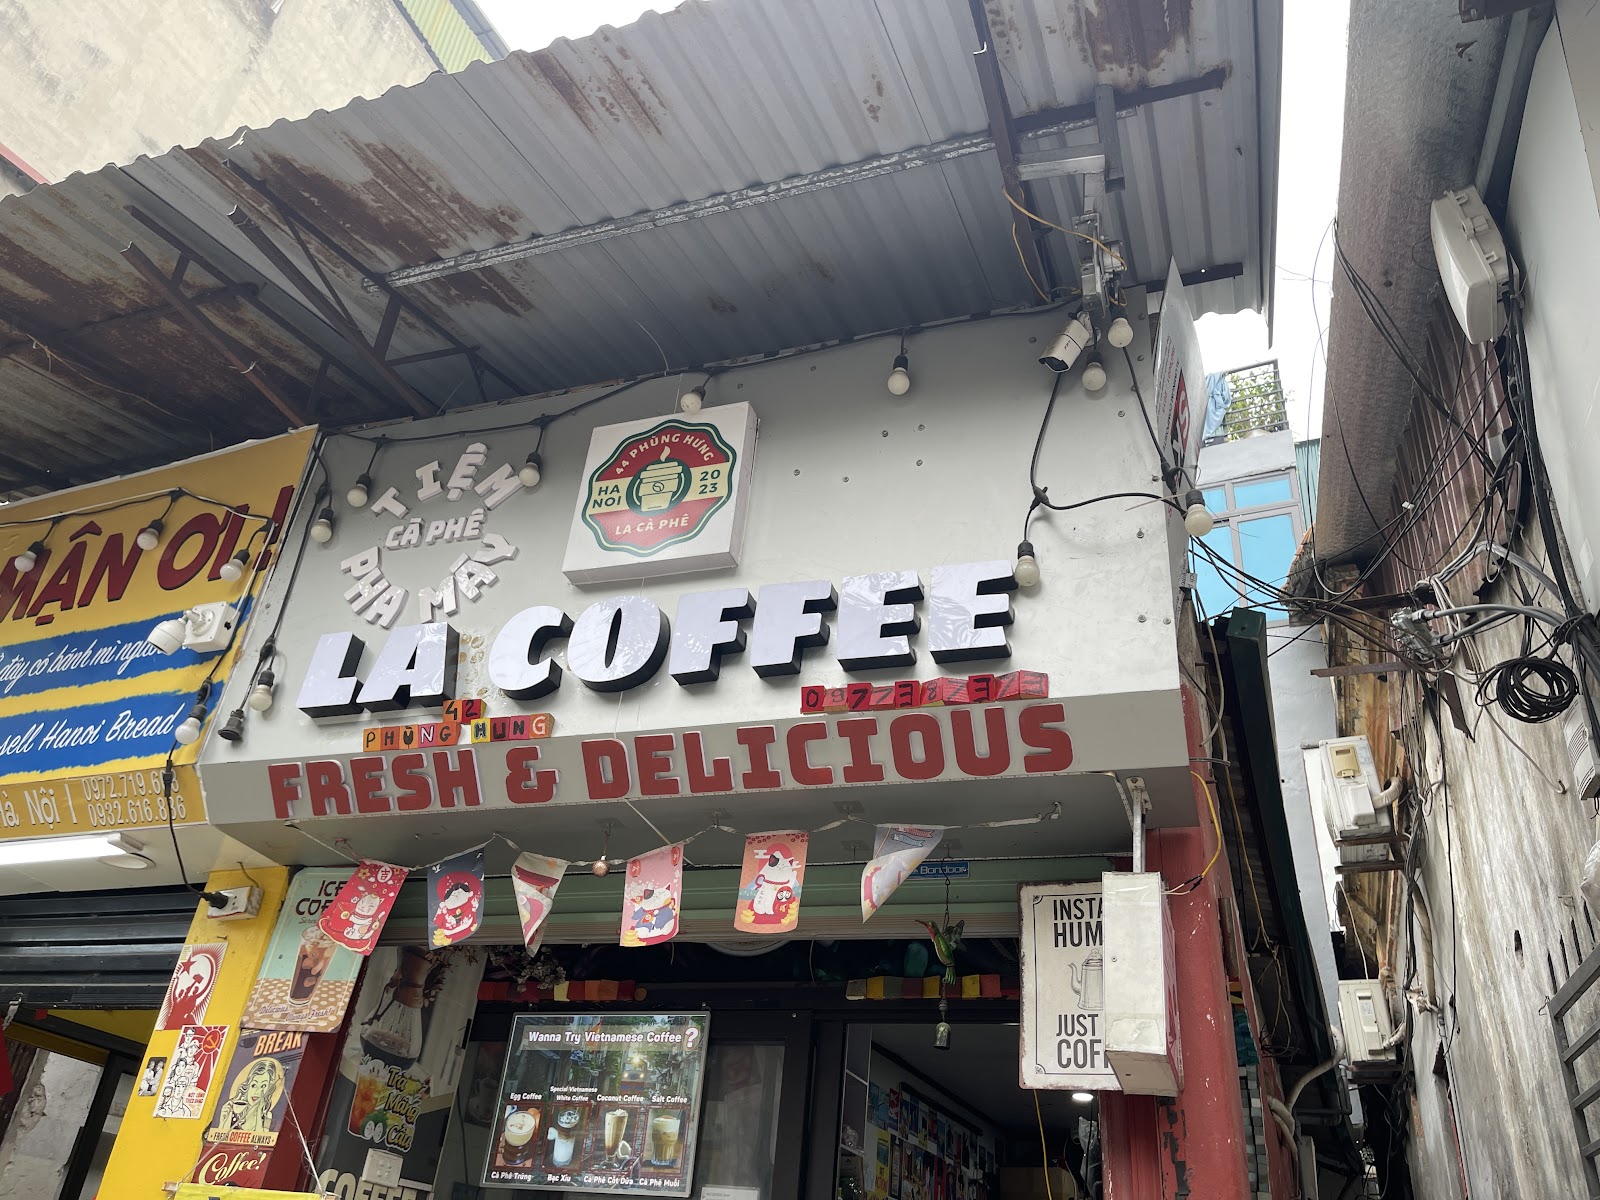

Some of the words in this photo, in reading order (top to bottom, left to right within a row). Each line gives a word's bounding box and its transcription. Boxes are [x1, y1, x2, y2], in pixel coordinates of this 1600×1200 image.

[615, 459, 630, 475] 44
[630, 433, 680, 459] PHÙNG
[371, 442, 523, 519] TIỆM
[700, 469, 721, 482] 20
[597, 485, 620, 496] HA
[699, 483, 718, 495] 23
[592, 496, 621, 509] NOI
[385, 517, 424, 550] CÀ
[425, 508, 487, 545] PHÊ
[615, 522, 632, 535] LA
[636, 518, 654, 533] CÀ
[658, 514, 690, 530] PHÊ
[340, 546, 409, 630] PHA
[296, 621, 460, 717] LA
[488, 559, 1019, 700] COFFEE
[28, 652, 54, 677] có
[46, 639, 98, 674] bánh
[445, 700, 478, 721] 42
[0, 723, 45, 756] sell
[38, 719, 106, 751] Hanoi
[105, 702, 186, 742] Bread
[267, 748, 483, 819] FRESH
[505, 745, 558, 804] &
[580, 703, 1074, 800] DELICIOUS
[23, 786, 61, 830] Nội
[1054, 921, 1103, 948] HUM
[1056, 1013, 1099, 1037] JUST
[253, 1031, 303, 1057] BREAK
[529, 1031, 562, 1043] Wanna
[564, 1031, 582, 1045] Try
[584, 1031, 644, 1043] Vietnamese
[646, 1031, 682, 1043] Coffee
[1057, 1038, 1110, 1069] COF
[387, 1067, 409, 1092] Trà
[510, 1093, 521, 1101] Egg
[522, 1093, 543, 1101] Coffee
[597, 1094, 622, 1102] Coconut
[652, 1095, 664, 1103] Salt
[666, 1096, 688, 1104] Coffee
[229, 1131, 252, 1143] COFFEE
[250, 1134, 271, 1145] ALWAYS
[198, 1151, 267, 1186] Coffee!
[491, 1171, 500, 1179] Cà
[500, 1171, 512, 1179] Phê
